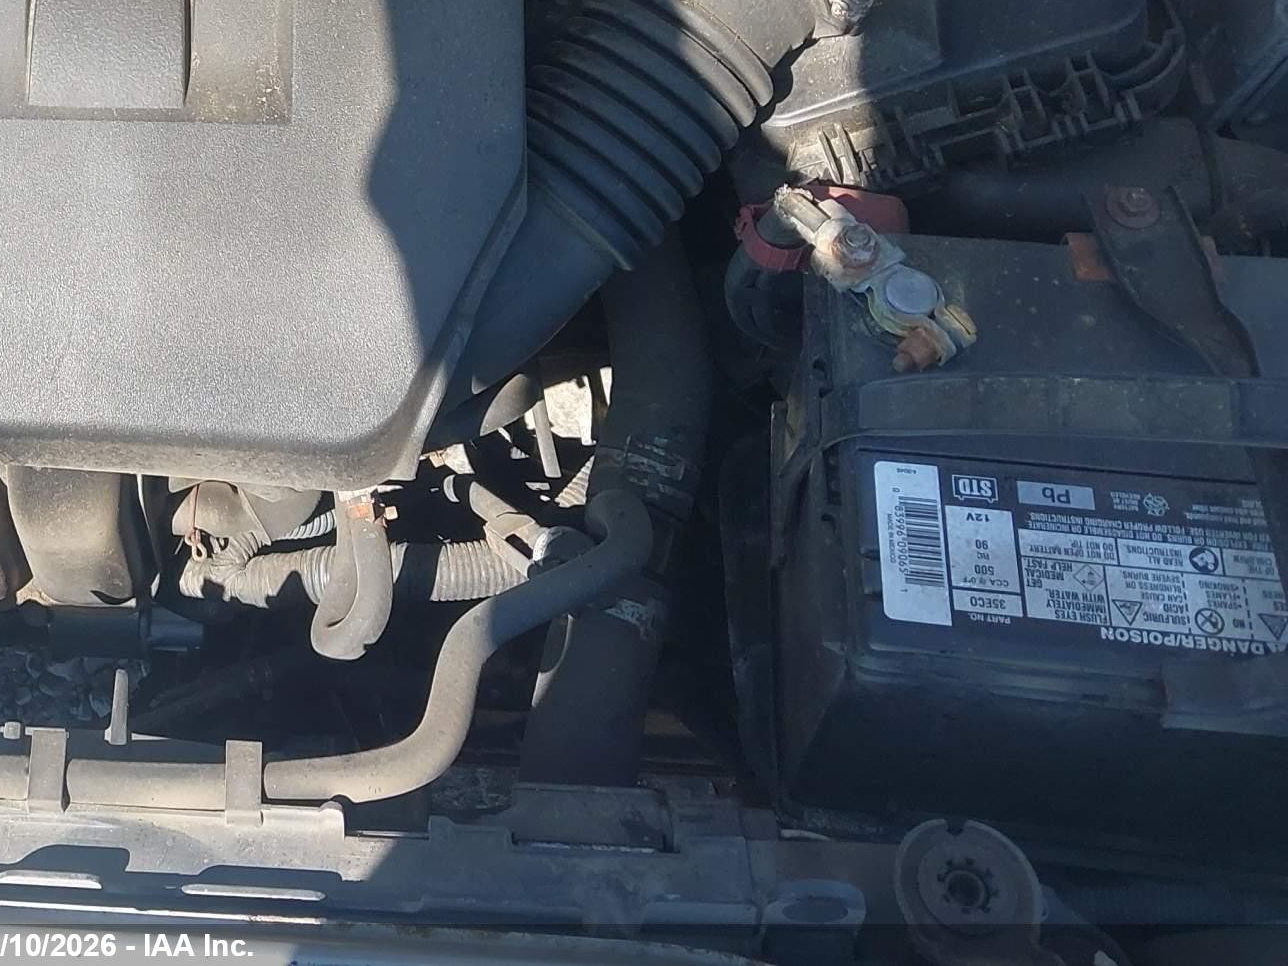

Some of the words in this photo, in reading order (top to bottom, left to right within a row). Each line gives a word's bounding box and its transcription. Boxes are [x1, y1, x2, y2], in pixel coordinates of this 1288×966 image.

[959, 479, 992, 495] STD
[1042, 488, 1070, 503] Pb
[966, 513, 990, 522] 12V
[975, 540, 988, 549] 90
[1024, 558, 1047, 568] FAST.
[1050, 561, 1072, 571] HELP
[974, 565, 995, 574] 500
[1025, 568, 1064, 580] MEDICAL
[991, 578, 1009, 586] CCA
[1026, 579, 1042, 588] GET
[1045, 589, 1079, 600] WATER.
[1081, 592, 1104, 603] WITH
[1166, 593, 1182, 602] CAN
[1046, 599, 1105, 612] IMMEDIATELY
[1163, 603, 1184, 612] ACID
[968, 613, 985, 621] NO.
[987, 615, 1011, 624] PART
[1055, 610, 1077, 619] EYES
[1080, 611, 1107, 623] FLUSH
[1143, 612, 1186, 625] SULFURIC
[1100, 626, 1265, 655] DANGER/POISON
